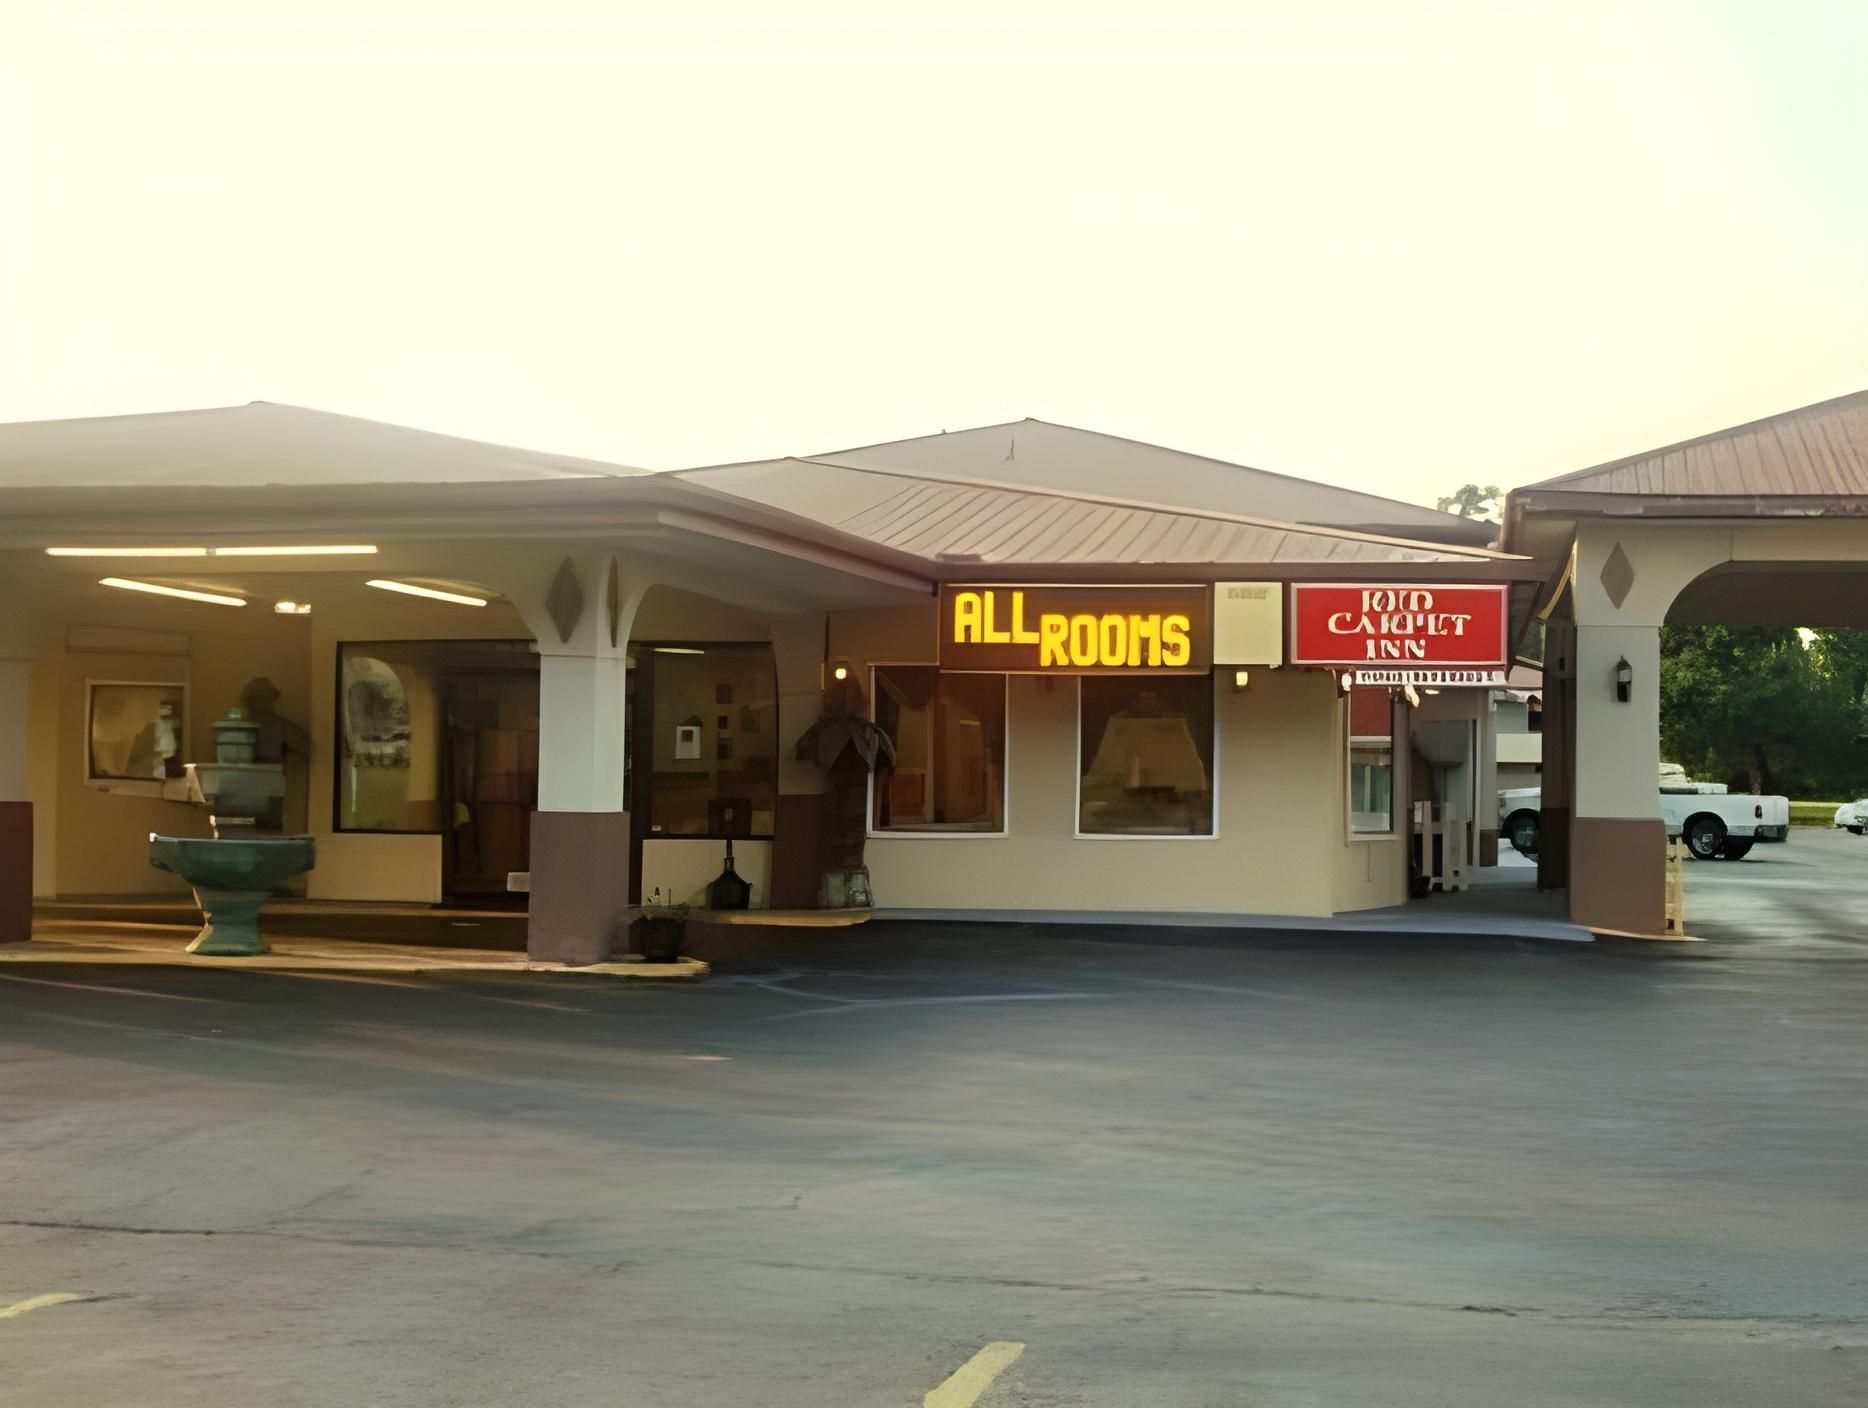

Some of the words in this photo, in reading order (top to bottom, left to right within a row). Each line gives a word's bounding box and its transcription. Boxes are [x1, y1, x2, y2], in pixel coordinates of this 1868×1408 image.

[954, 591, 1040, 643] ALL
[1040, 614, 1191, 667] ROOMS
[1366, 639, 1426, 659] INN
